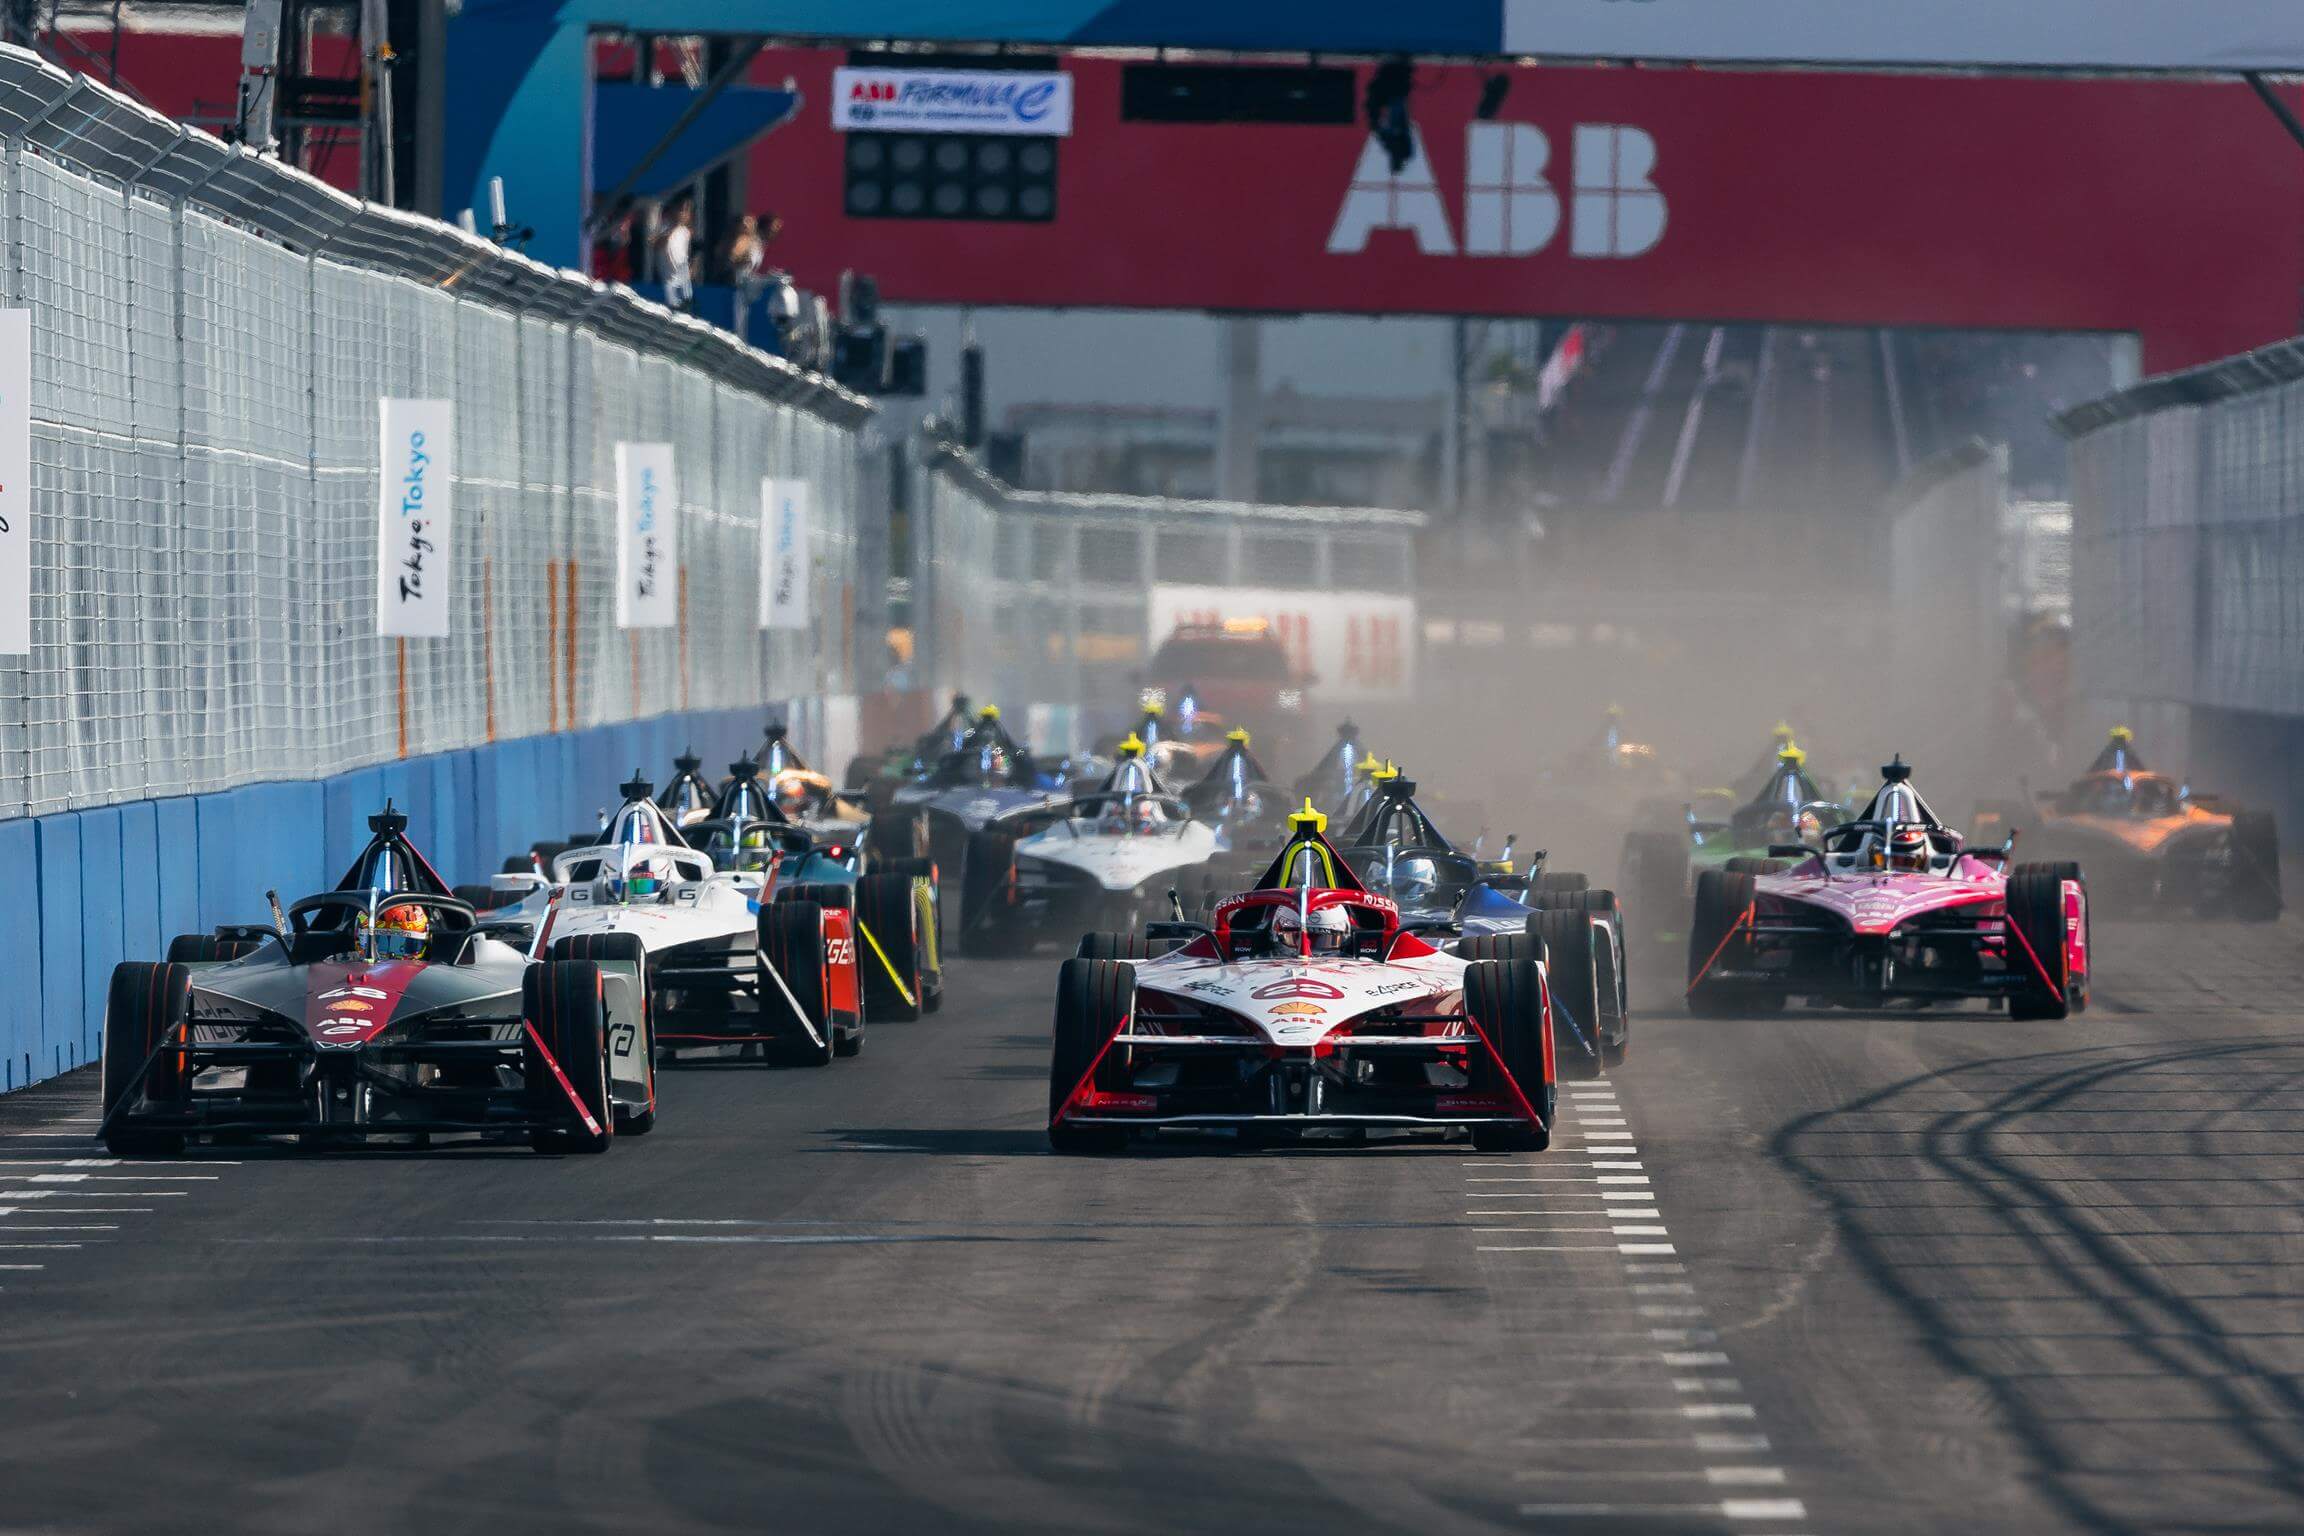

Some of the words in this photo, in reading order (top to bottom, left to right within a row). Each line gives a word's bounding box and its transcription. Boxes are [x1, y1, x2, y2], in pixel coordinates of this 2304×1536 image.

[1325, 119, 1669, 259] ABB
[402, 430, 430, 517] Tokyo
[400, 519, 433, 604] Tokyo
[571, 890, 589, 901] G
[679, 889, 696, 900] G
[318, 986, 388, 1000] 48
[316, 1017, 373, 1027] ABB
[1271, 1016, 1324, 1025] ABB
